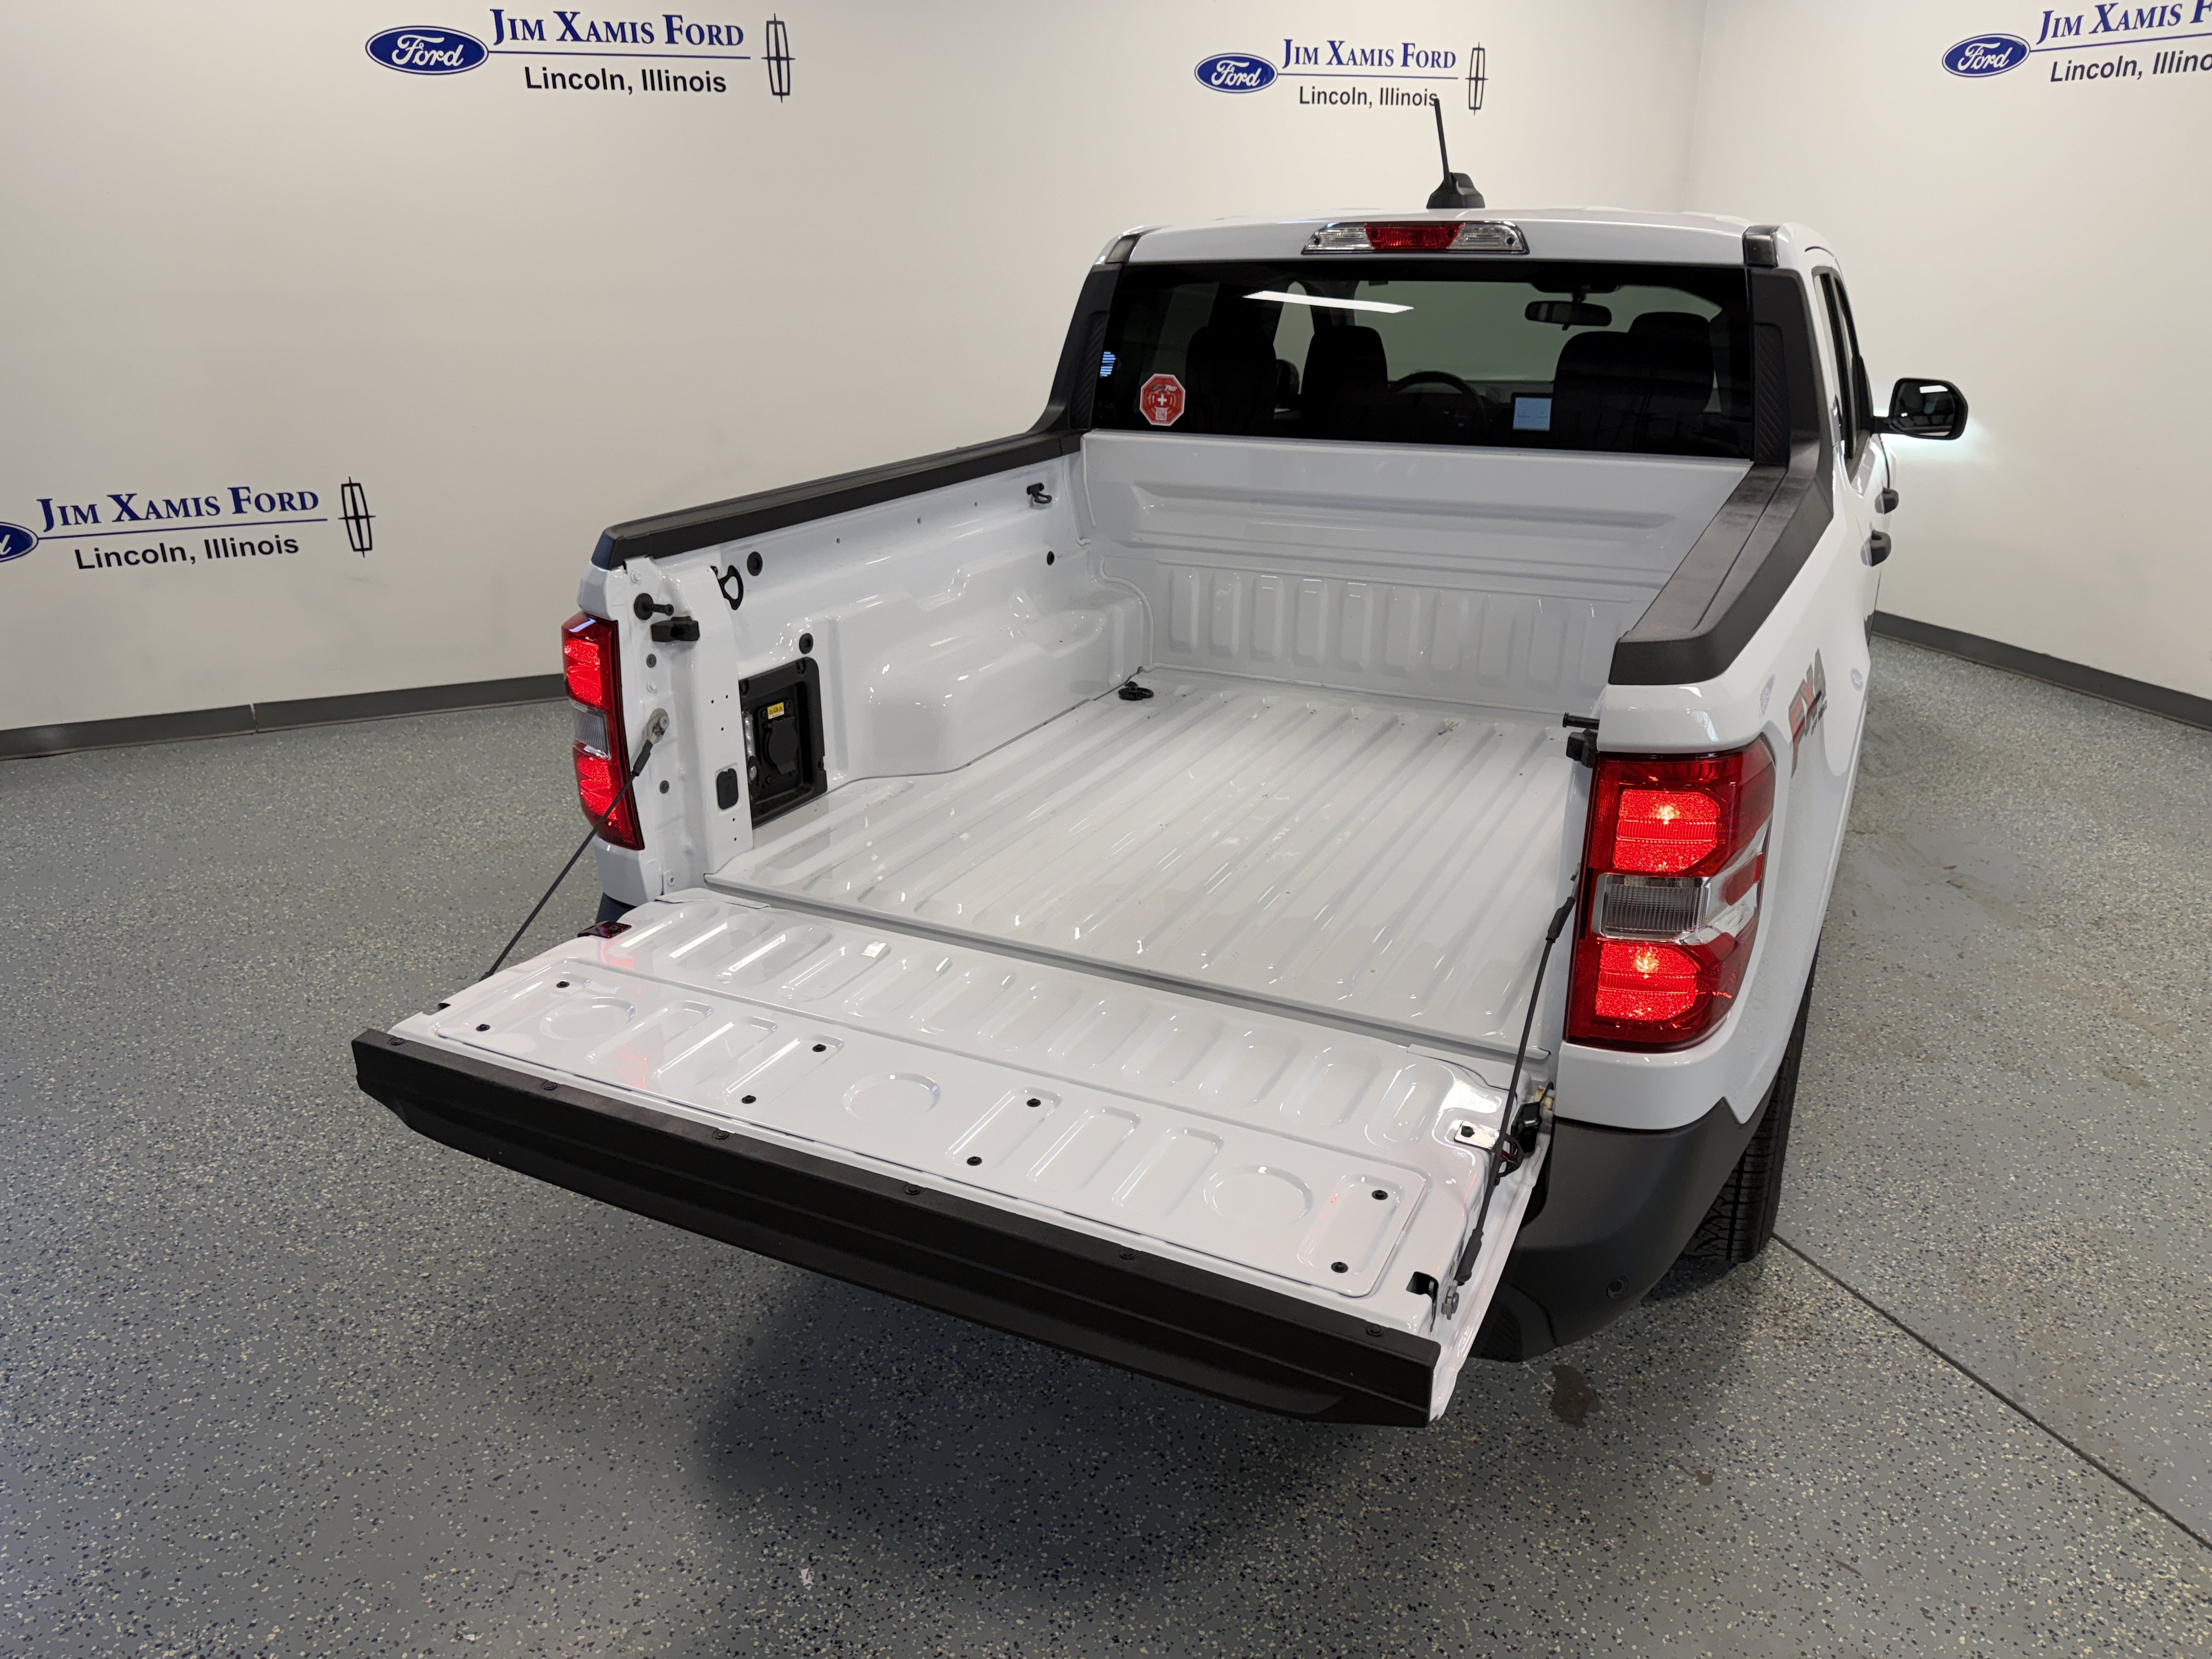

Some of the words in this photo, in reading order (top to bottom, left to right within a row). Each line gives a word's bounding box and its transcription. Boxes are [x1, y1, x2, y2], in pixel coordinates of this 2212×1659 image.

[391, 34, 465, 67] Ford
[1957, 42, 2012, 70] Ford
[524, 66, 633, 95] Lincoln,
[641, 69, 727, 92] Illinois
[1211, 60, 1261, 87] Ford
[2050, 55, 2143, 82] Lincoln,
[2152, 50, 2212, 75] Illino
[1299, 86, 1372, 109] Lincoln,
[1380, 87, 1437, 106] Illinois
[75, 542, 196, 569] Lincoln,
[204, 534, 300, 559] Illinois
